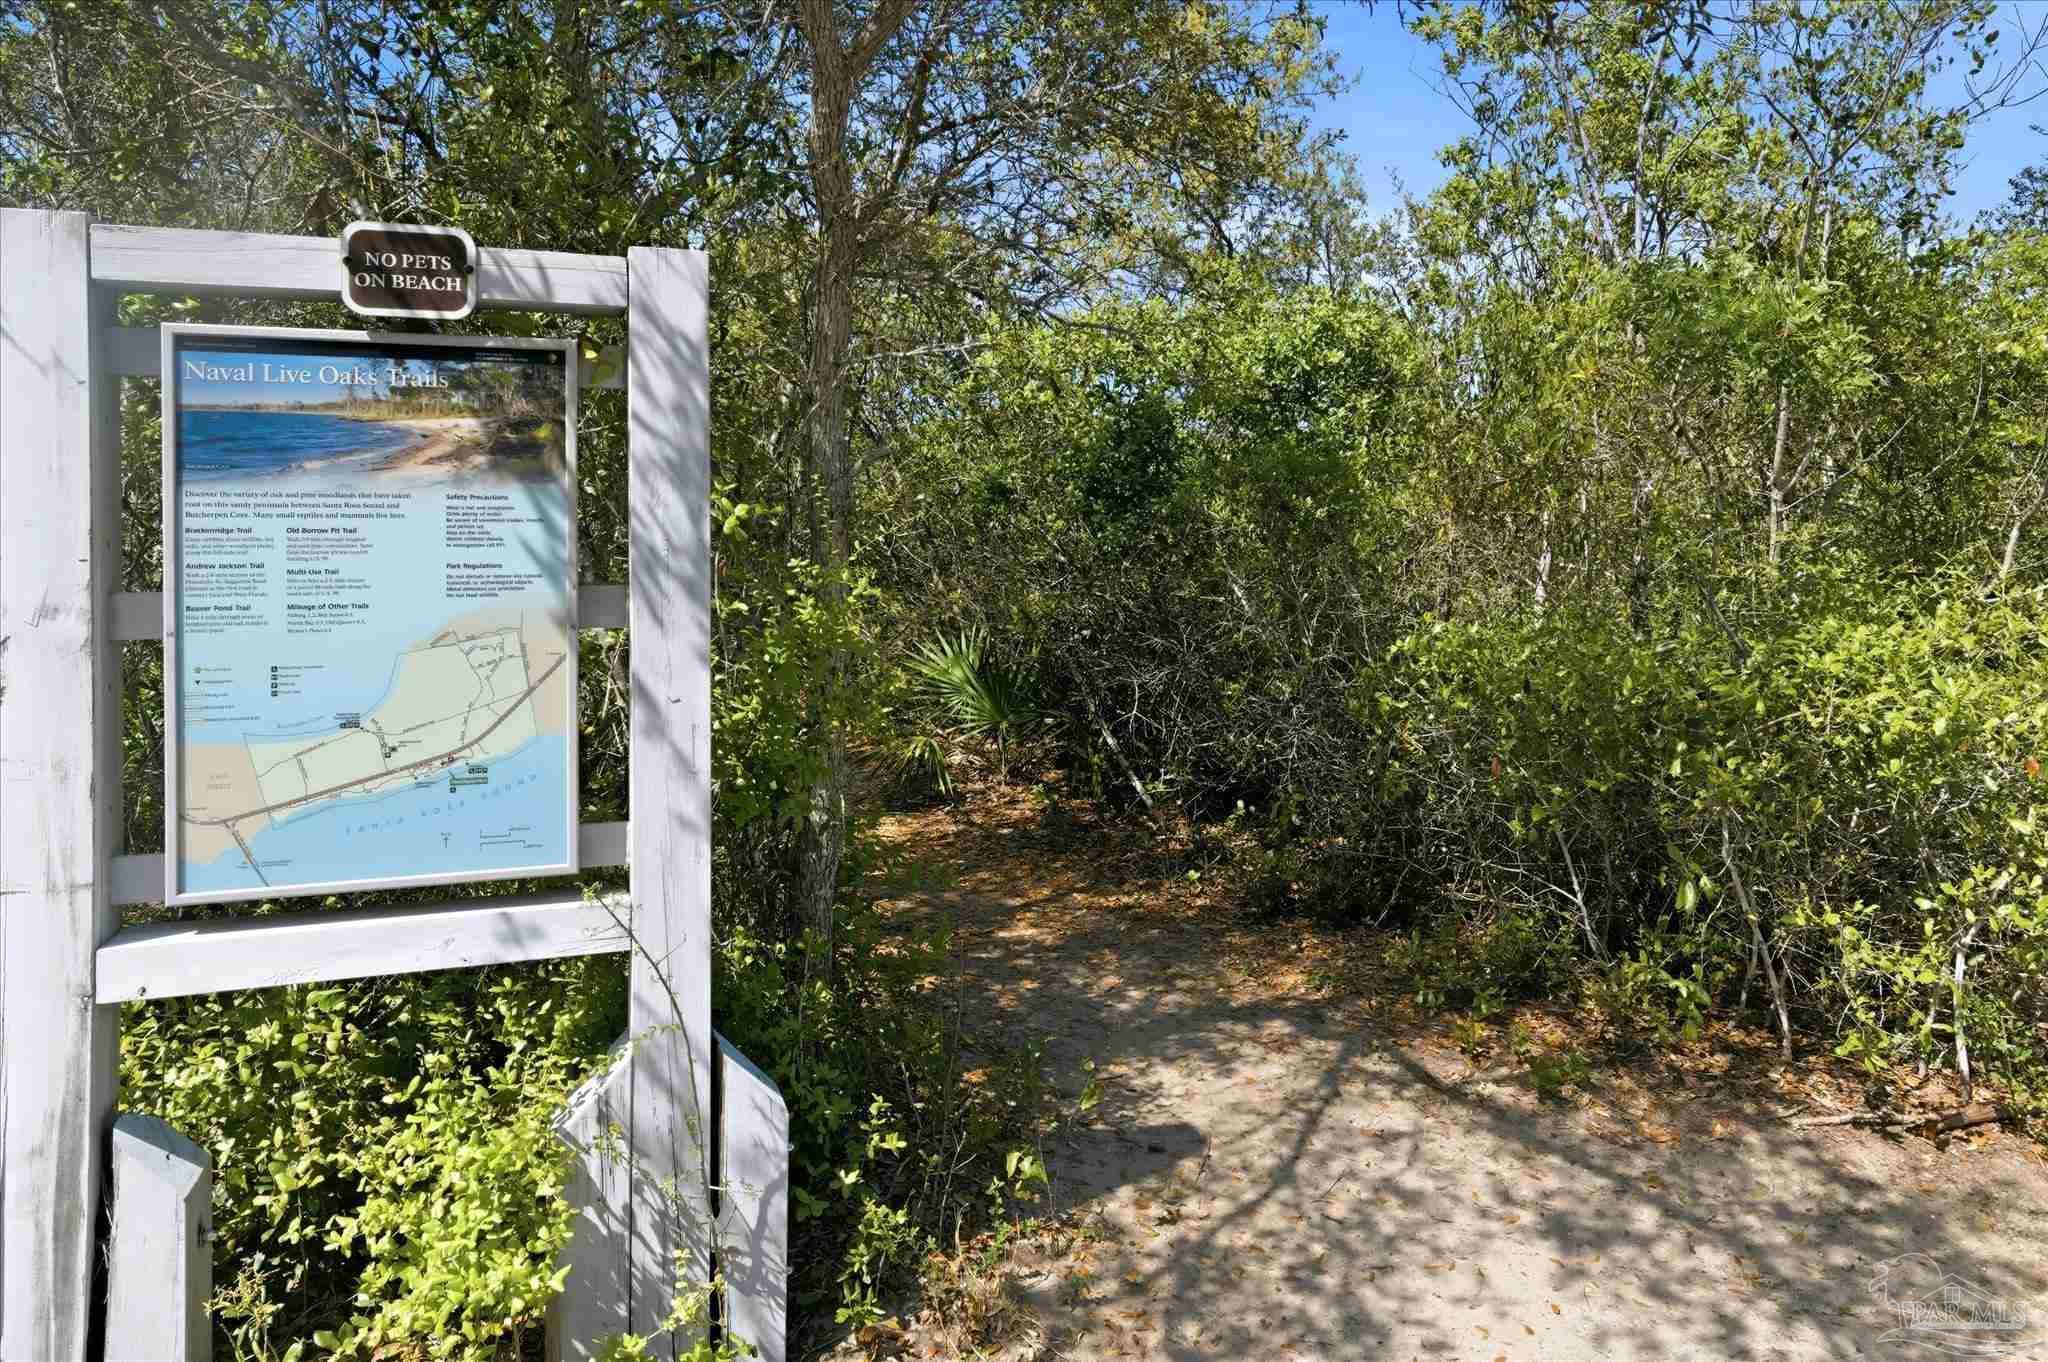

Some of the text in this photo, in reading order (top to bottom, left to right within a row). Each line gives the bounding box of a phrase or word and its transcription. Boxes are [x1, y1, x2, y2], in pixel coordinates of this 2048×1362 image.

[364, 251, 452, 271] NO PETS
[354, 272, 462, 292] ON BEACH
[184, 359, 449, 389] Naval Live Oaks Trails
[446, 494, 468, 502] Safety
[236, 527, 253, 535] Trail
[285, 527, 299, 535] Old
[342, 527, 358, 535] Trail
[184, 562, 265, 570] Andrew Jackson Trail
[323, 568, 339, 576] Trail
[318, 603, 327, 611] of
[327, 603, 349, 611] Other
